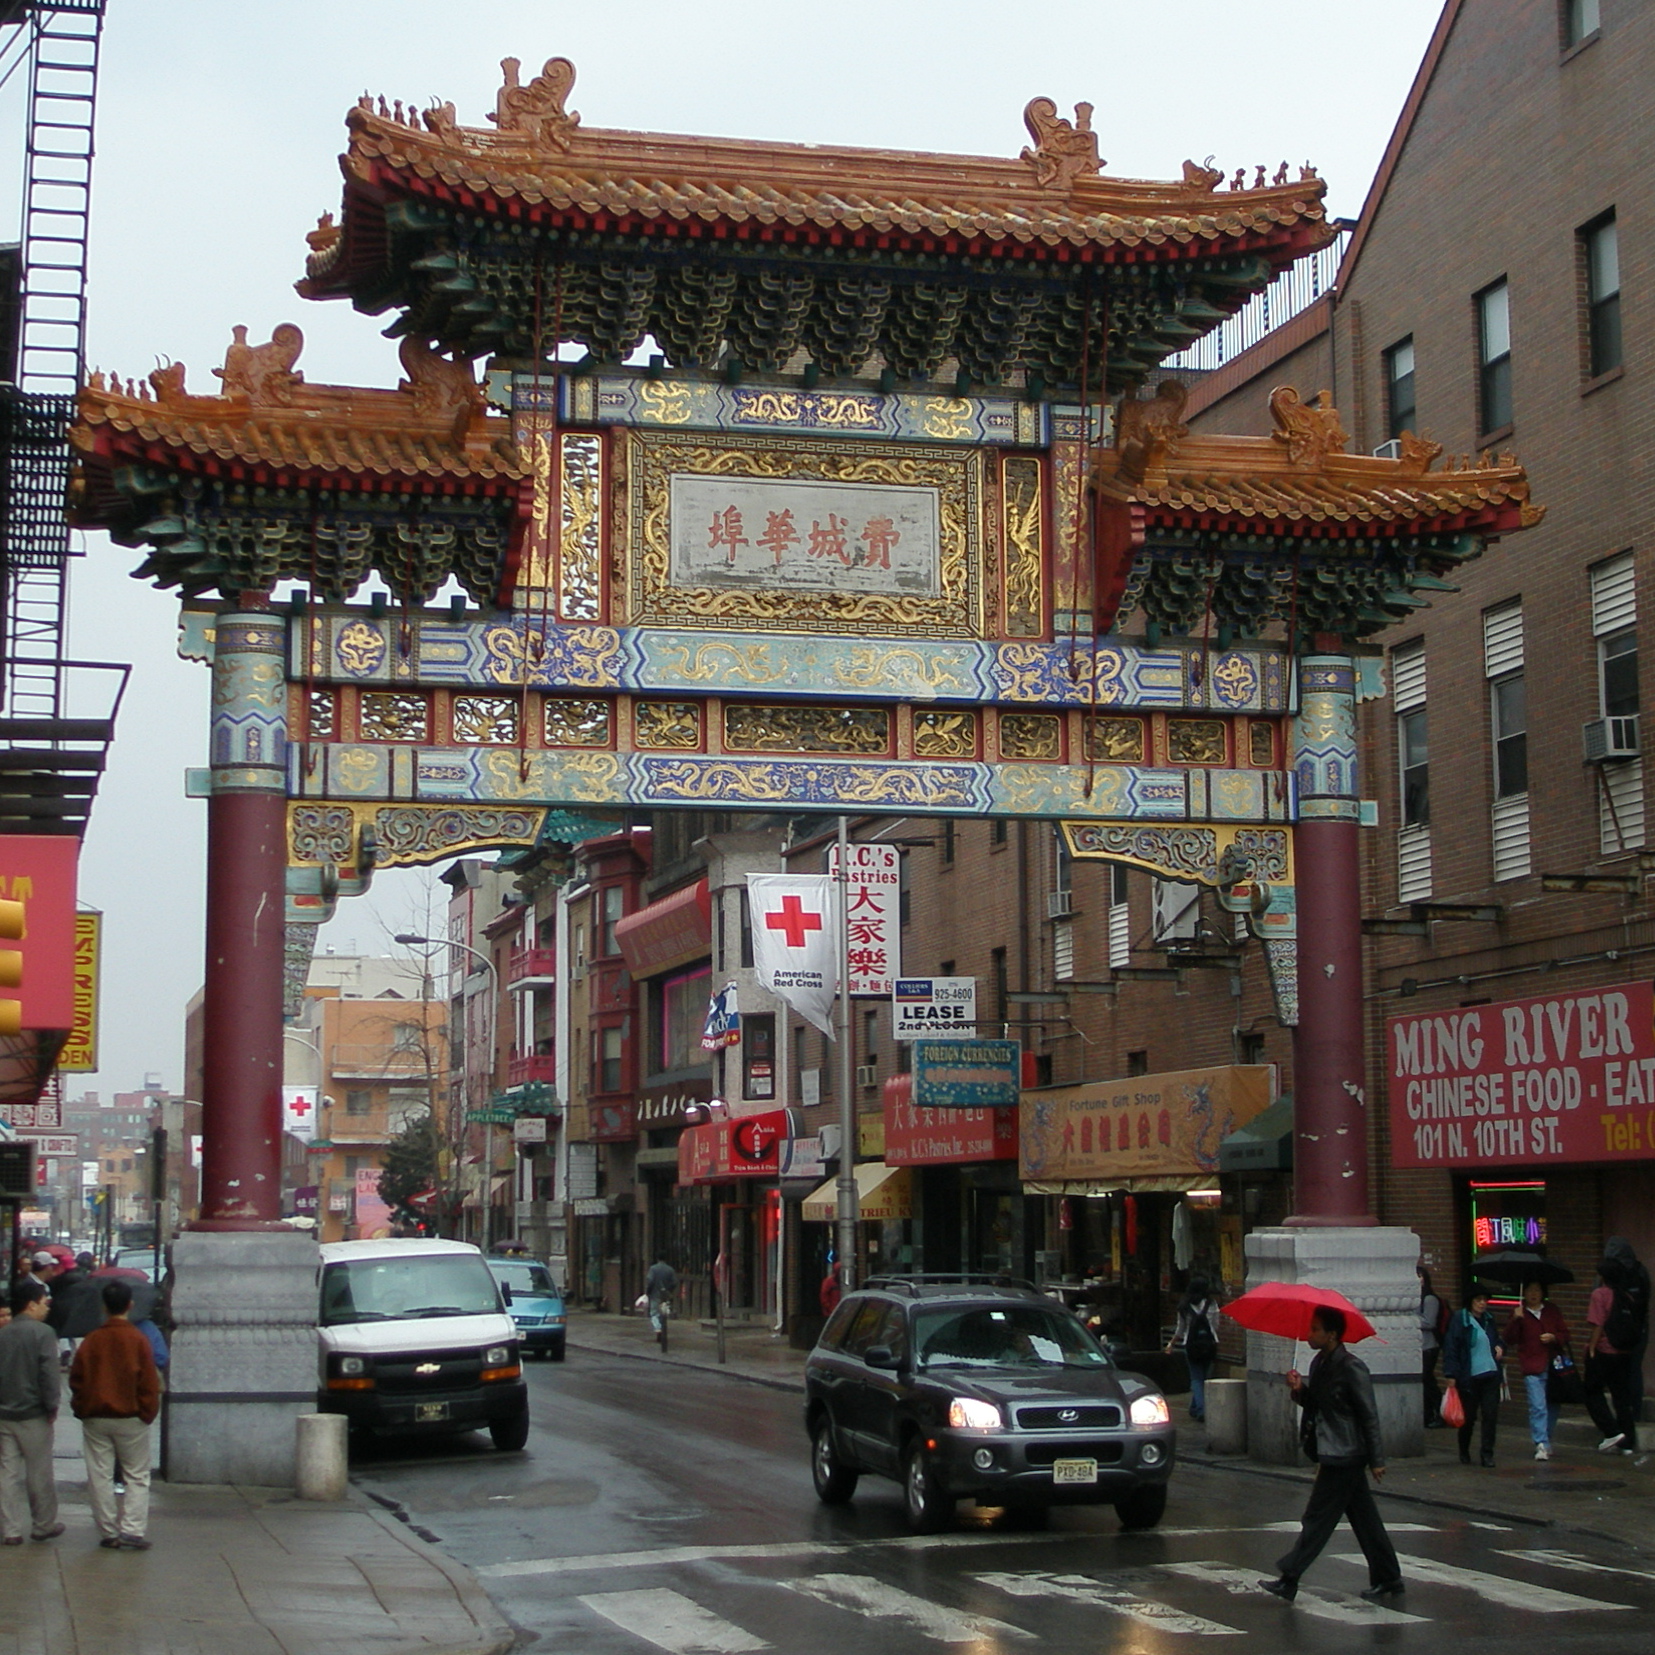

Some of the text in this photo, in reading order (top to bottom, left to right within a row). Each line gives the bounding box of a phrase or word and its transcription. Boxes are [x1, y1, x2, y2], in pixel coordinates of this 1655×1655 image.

[774, 970, 822, 979] American
[773, 979, 823, 988] Red Cross
[934, 988, 972, 1000] 925-4600
[903, 1006, 965, 1019] LEASE
[898, 1021, 922, 1030] 2nd
[1394, 992, 1635, 1077] MING RIVER
[924, 1046, 1012, 1063] FOREIGN CURRENCIES
[1406, 1073, 1505, 1120] CHINESE
[1511, 1066, 1582, 1113] FOOD
[1069, 1093, 1161, 1111] Fortune Gift Shop
[1414, 1123, 1443, 1159] 101
[1448, 1122, 1468, 1158] N.
[1473, 1118, 1525, 1157] 10TH
[1530, 1116, 1563, 1155] ST.
[1601, 1112, 1641, 1152] Tel:
[358, 1170, 380, 1181] ENG
[358, 1183, 378, 1194] LAD
[860, 1207, 892, 1217] TRIEU
